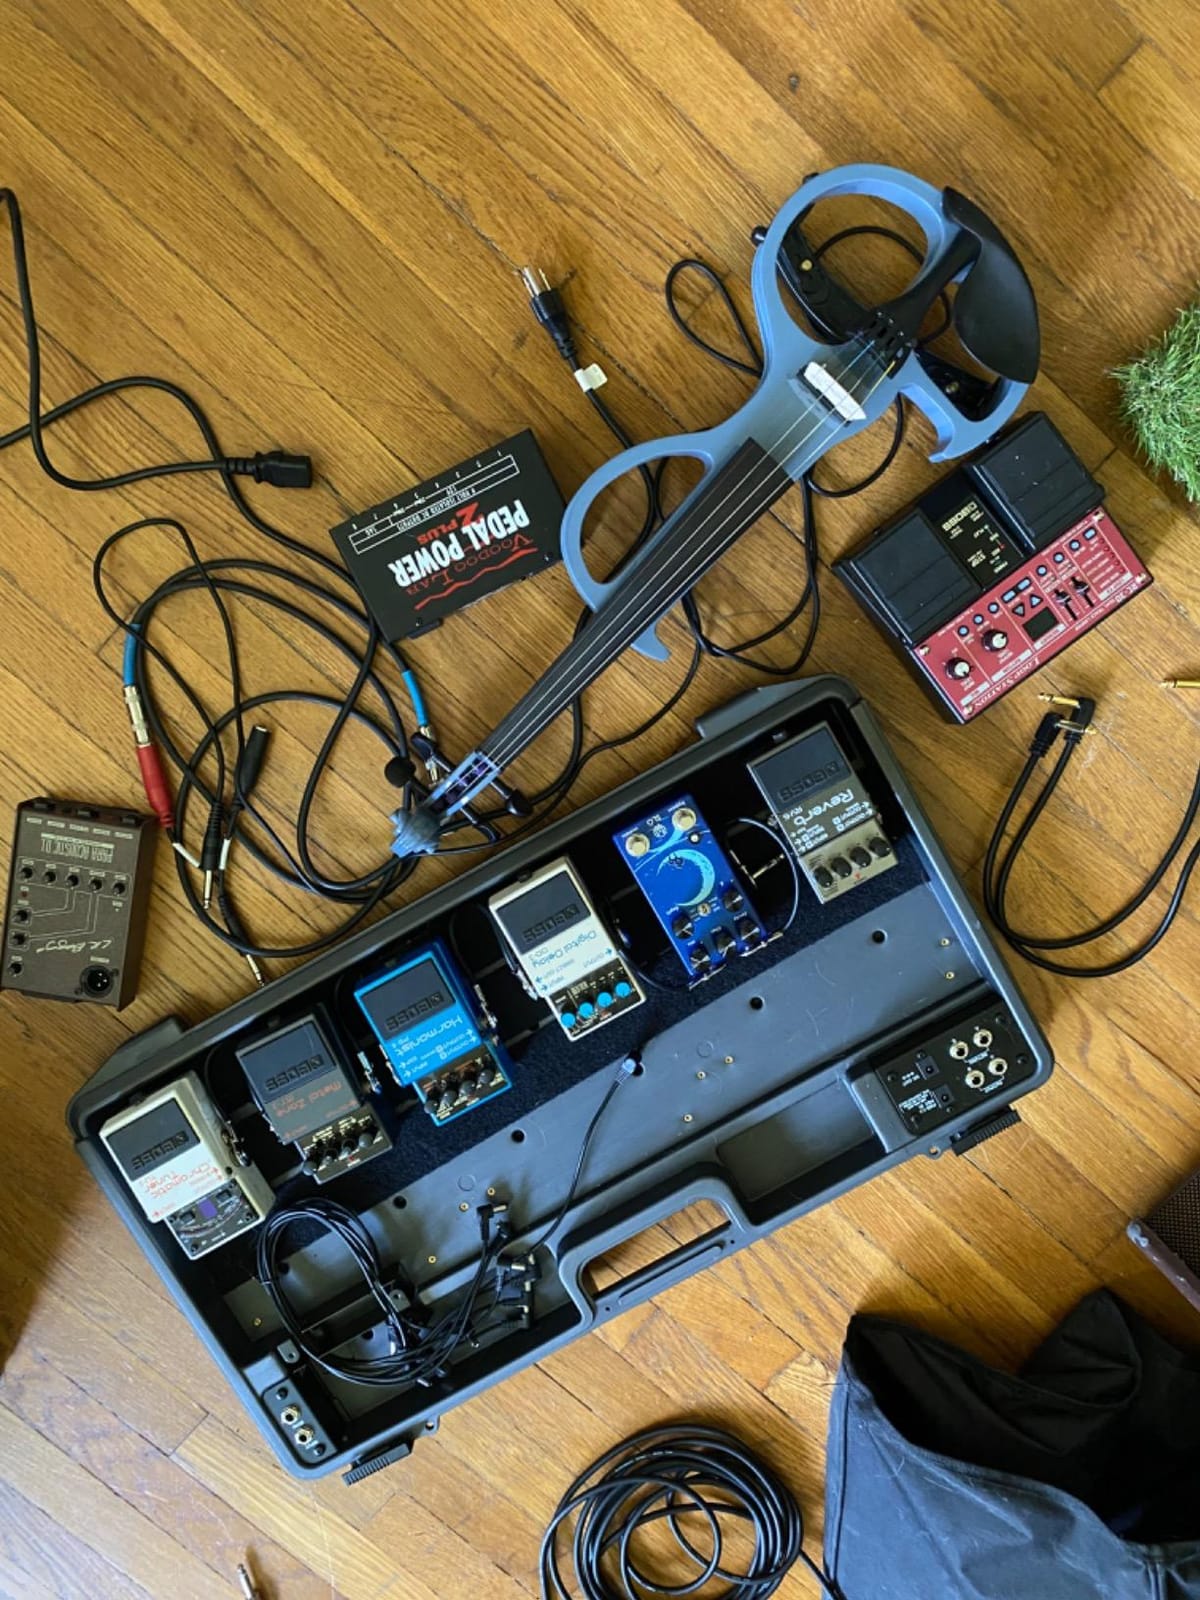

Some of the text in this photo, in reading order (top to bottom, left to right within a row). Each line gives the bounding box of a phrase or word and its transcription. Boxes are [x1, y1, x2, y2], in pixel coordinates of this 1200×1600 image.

[386, 498, 531, 589] PEDAL POWER
[415, 501, 482, 546] 2 PLUS
[791, 787, 855, 831] Reverb
[91, 847, 113, 862] PARA
[531, 927, 598, 971] Digital Delay
[393, 1014, 462, 1057] Harmonist
[274, 1078, 342, 1120] Metal Zone
[142, 1168, 178, 1193] Tuner
[149, 1161, 211, 1200] Chromatic
